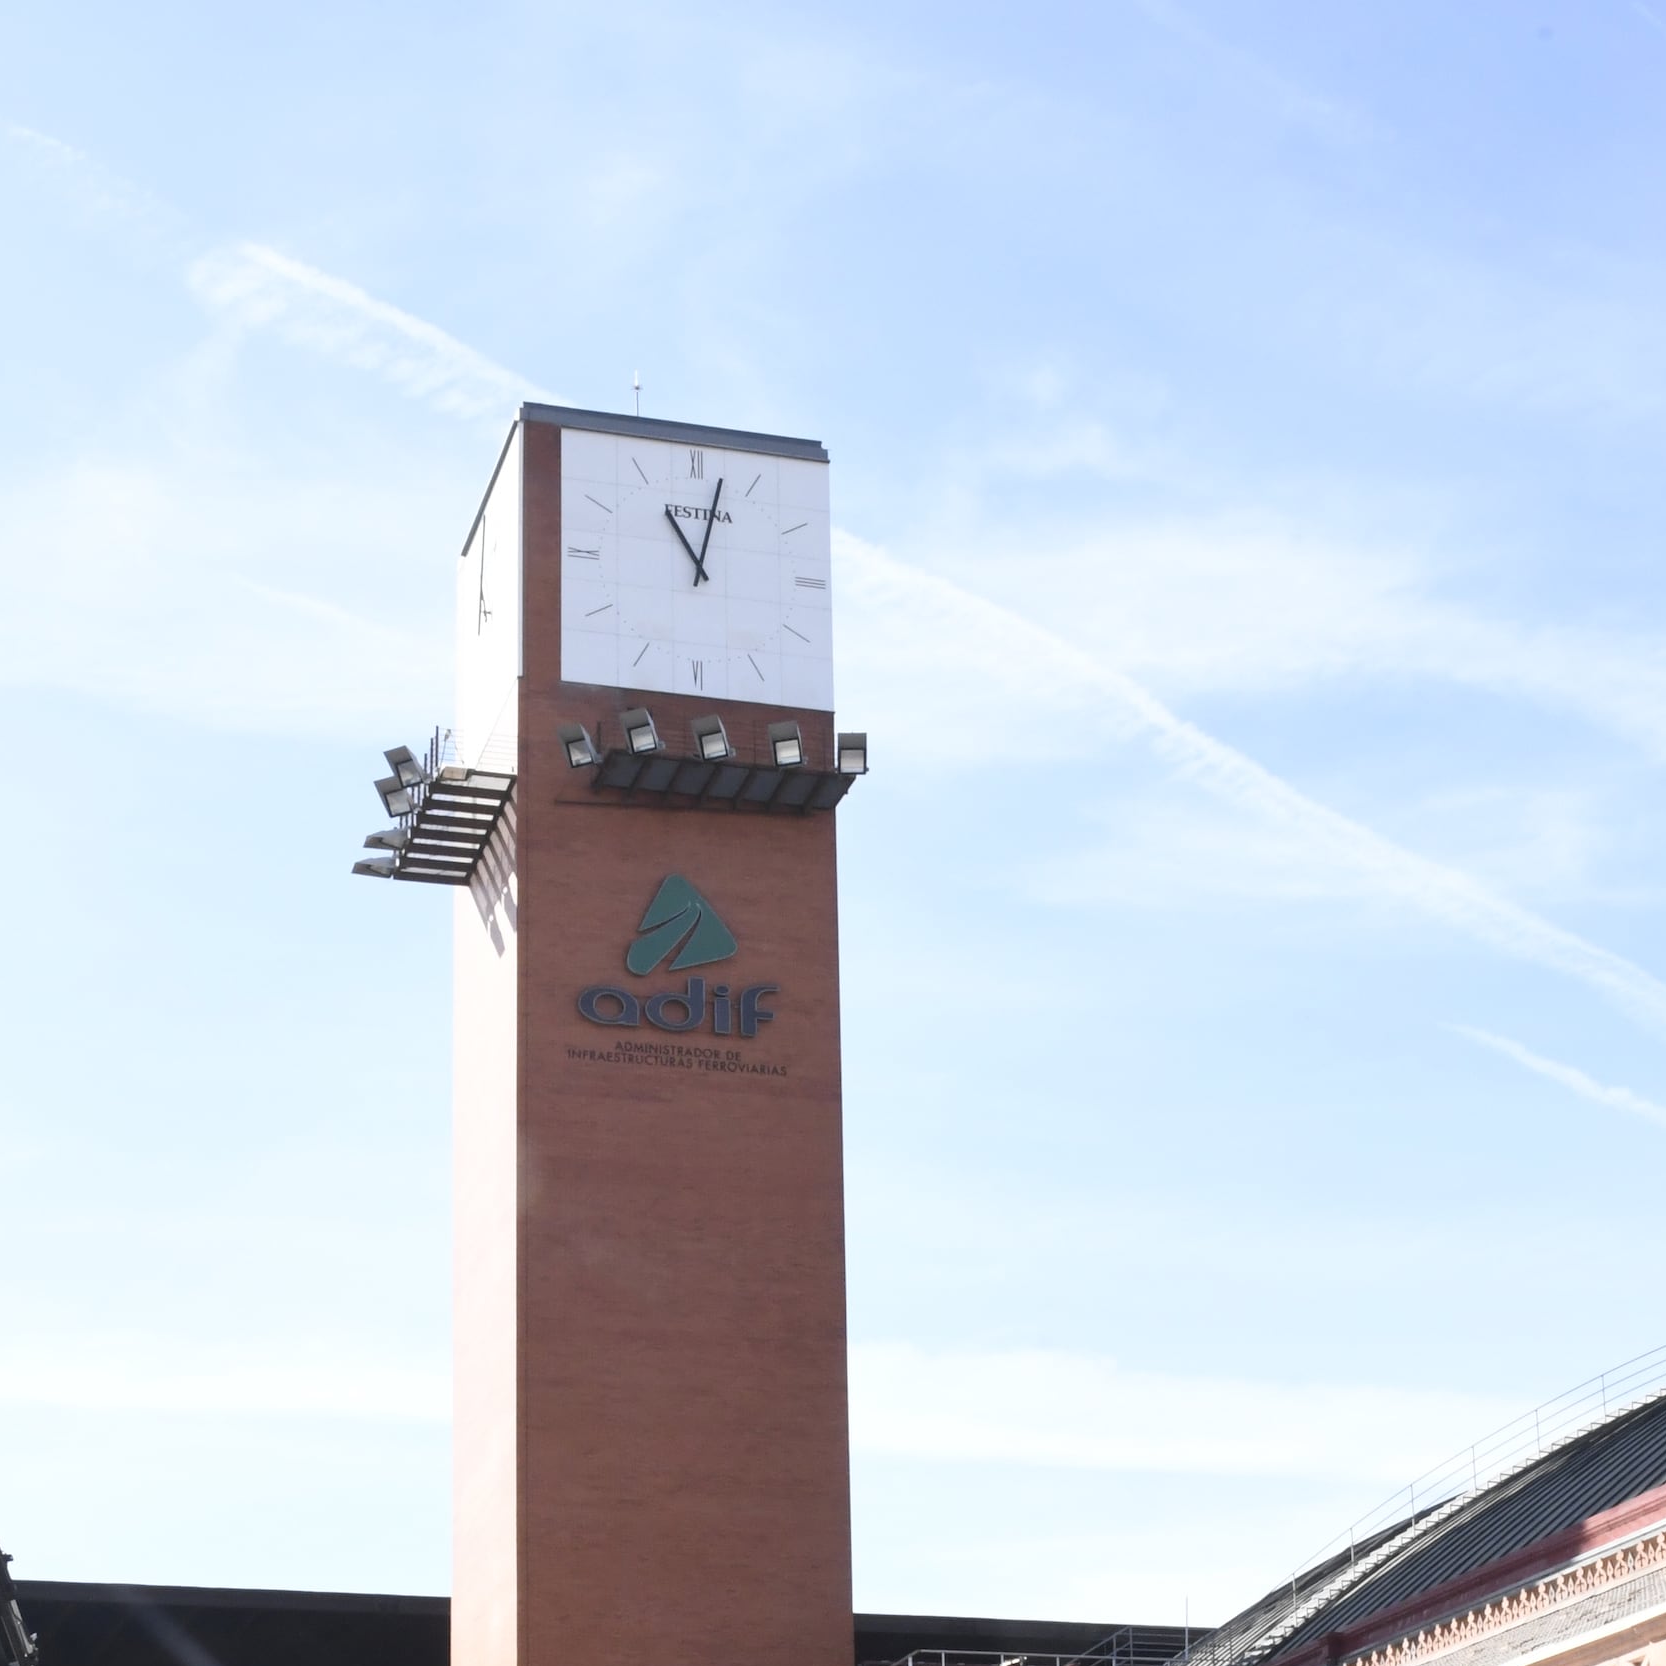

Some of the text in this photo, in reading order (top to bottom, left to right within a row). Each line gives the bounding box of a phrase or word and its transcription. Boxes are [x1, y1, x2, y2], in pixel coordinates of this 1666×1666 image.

[665, 503, 733, 523] FESTINA
[578, 976, 781, 1037] adif
[567, 1049, 787, 1077] INFRAESTRUCTURAS FERROVIARIAS
[615, 1041, 741, 1062] ADMINISTRADOR DE
